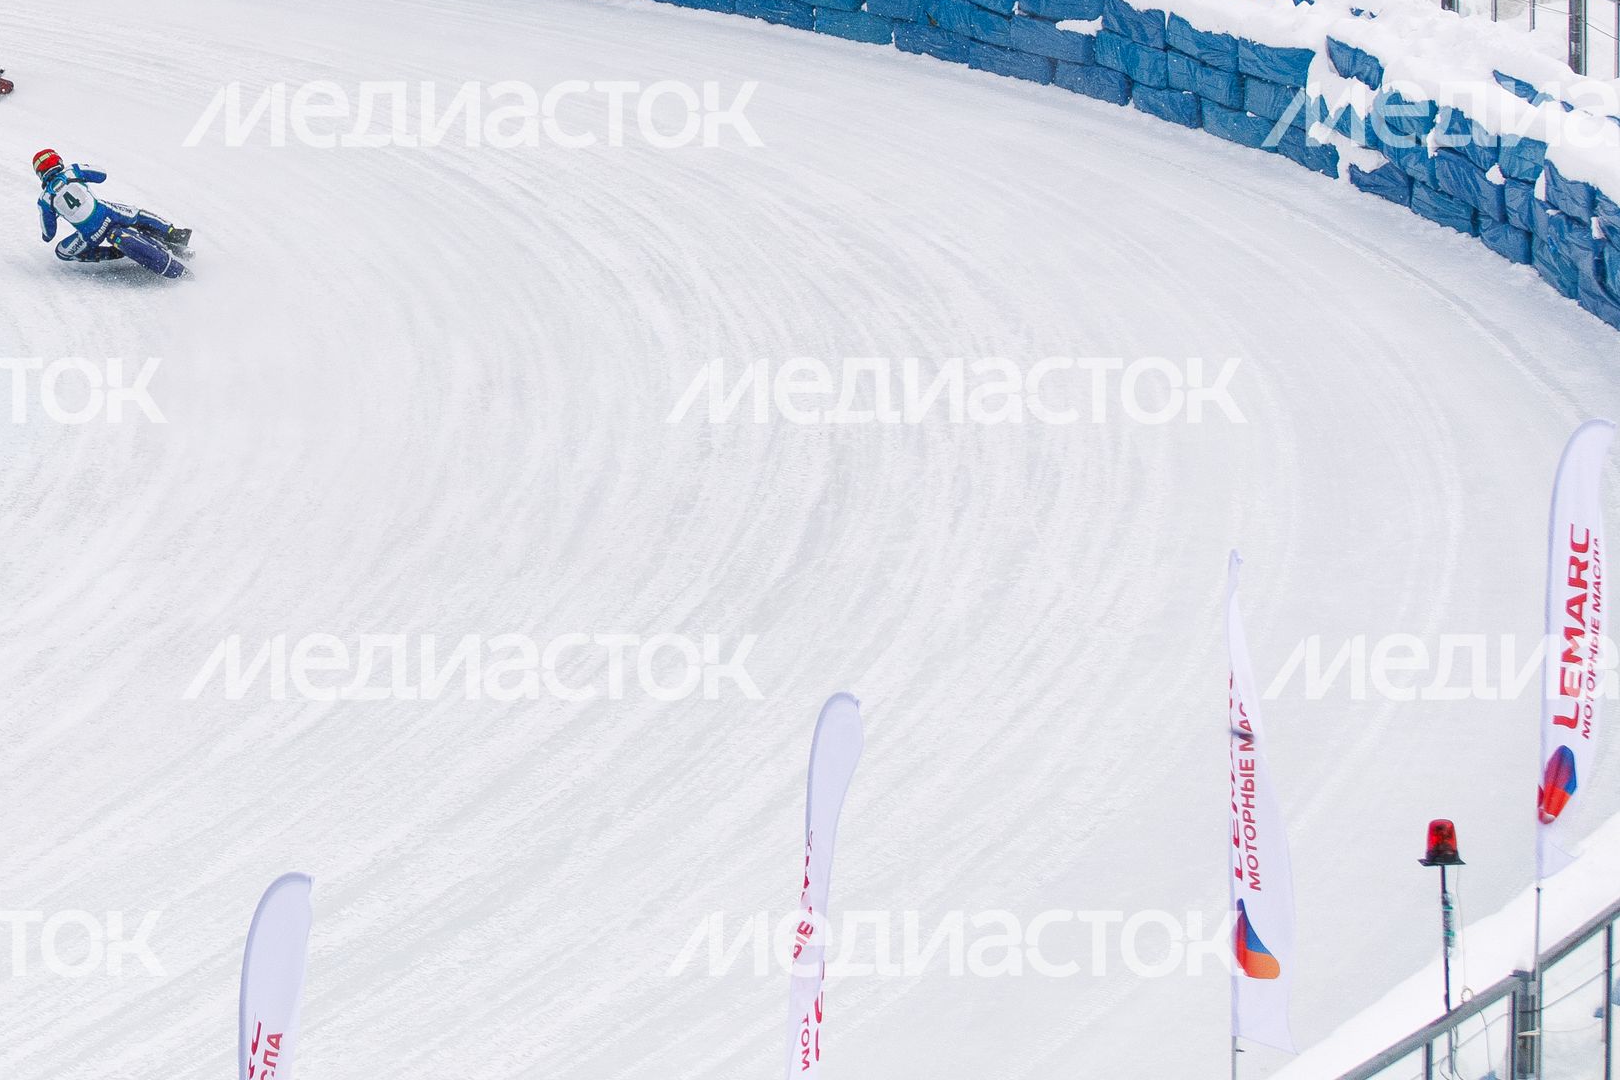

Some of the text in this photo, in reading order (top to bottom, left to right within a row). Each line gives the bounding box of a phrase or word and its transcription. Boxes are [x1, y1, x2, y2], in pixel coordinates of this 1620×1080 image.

[62, 191, 82, 210] 4
[1552, 522, 1590, 730] LEMARC
[1582, 536, 1603, 740] МОТОРНЫЕ МАСЛА
[1238, 757, 1262, 892] МОТОРНЫЕ
